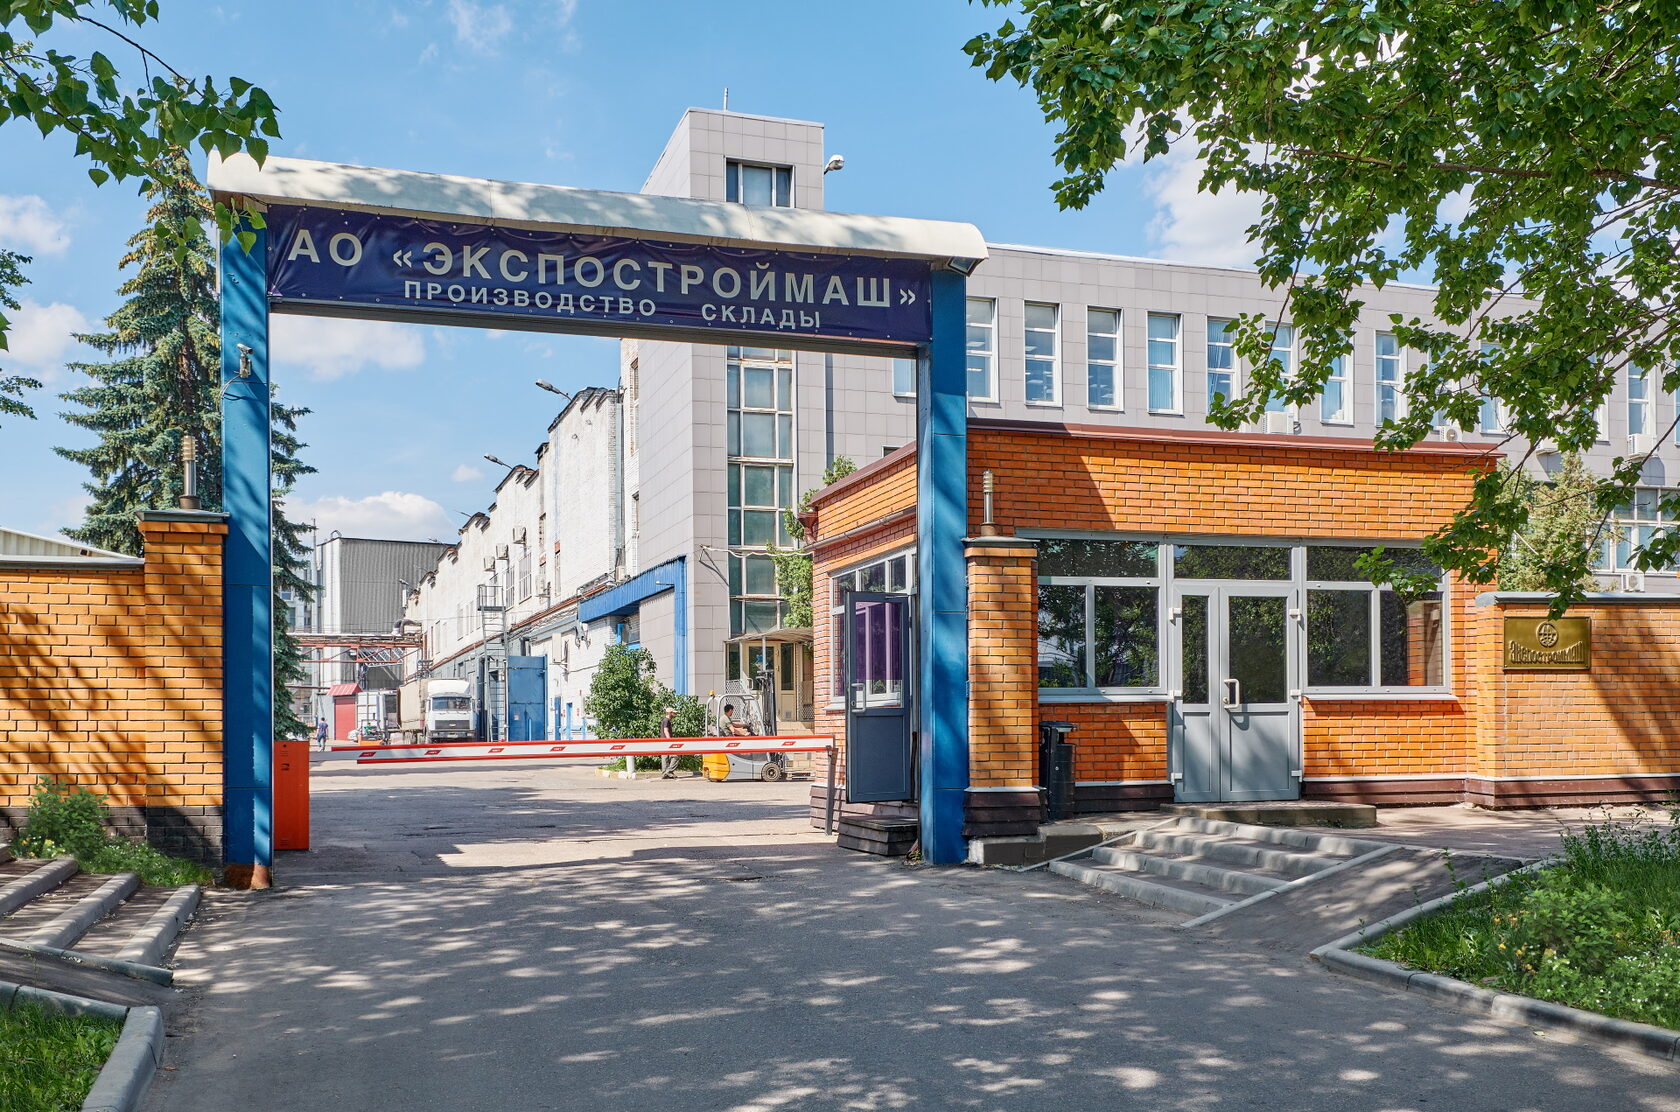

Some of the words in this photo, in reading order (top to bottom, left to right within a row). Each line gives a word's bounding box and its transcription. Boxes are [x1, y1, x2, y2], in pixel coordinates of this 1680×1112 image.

[288, 229, 363, 266] АО
[392, 242, 916, 308] «ЭКСПОСТРОЙМАШ»
[404, 280, 656, 316] ПРОИЗВОДСТВО
[701, 303, 821, 330] СКЛАДЫ
